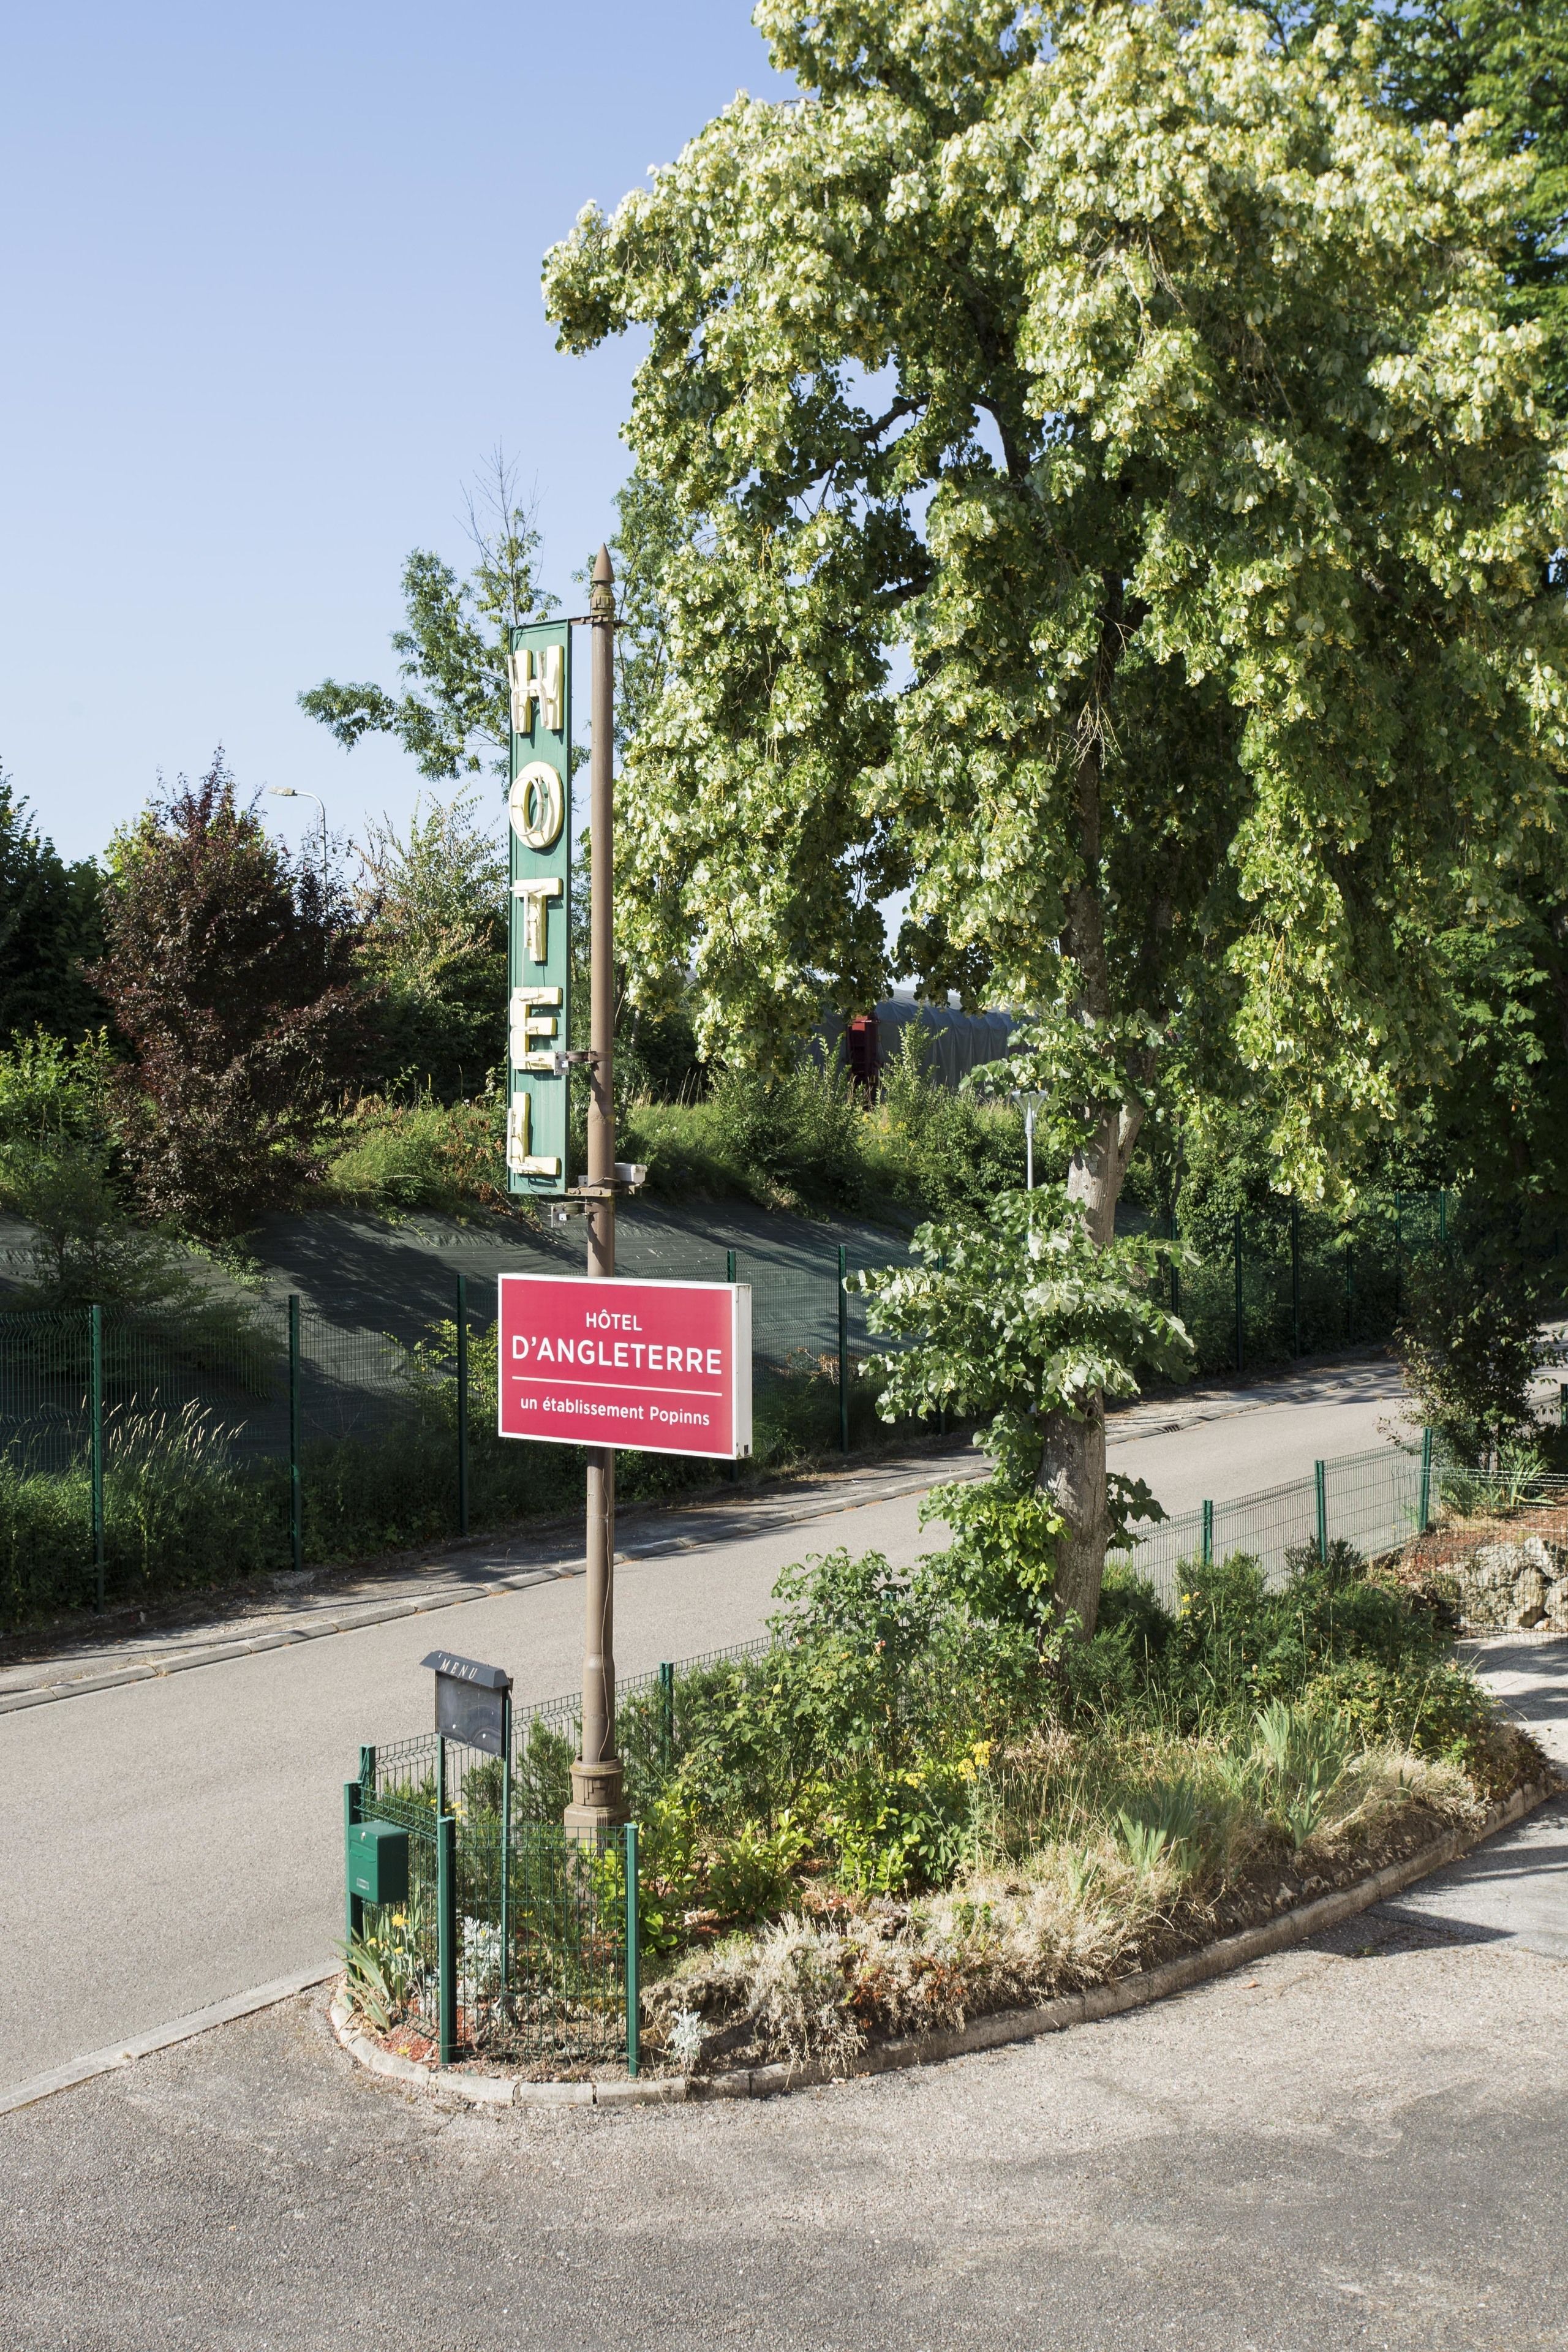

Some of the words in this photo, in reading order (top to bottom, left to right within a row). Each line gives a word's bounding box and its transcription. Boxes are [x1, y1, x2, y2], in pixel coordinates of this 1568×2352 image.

[507, 644, 564, 1175] HOTEL
[586, 1310, 643, 1331] HÔTEL
[511, 1335, 722, 1374] D'ANGLETERRE
[521, 1397, 537, 1410] un
[543, 1396, 644, 1420] établissement
[650, 1406, 710, 1426] Popinns
[440, 1659, 478, 1679] MENU
